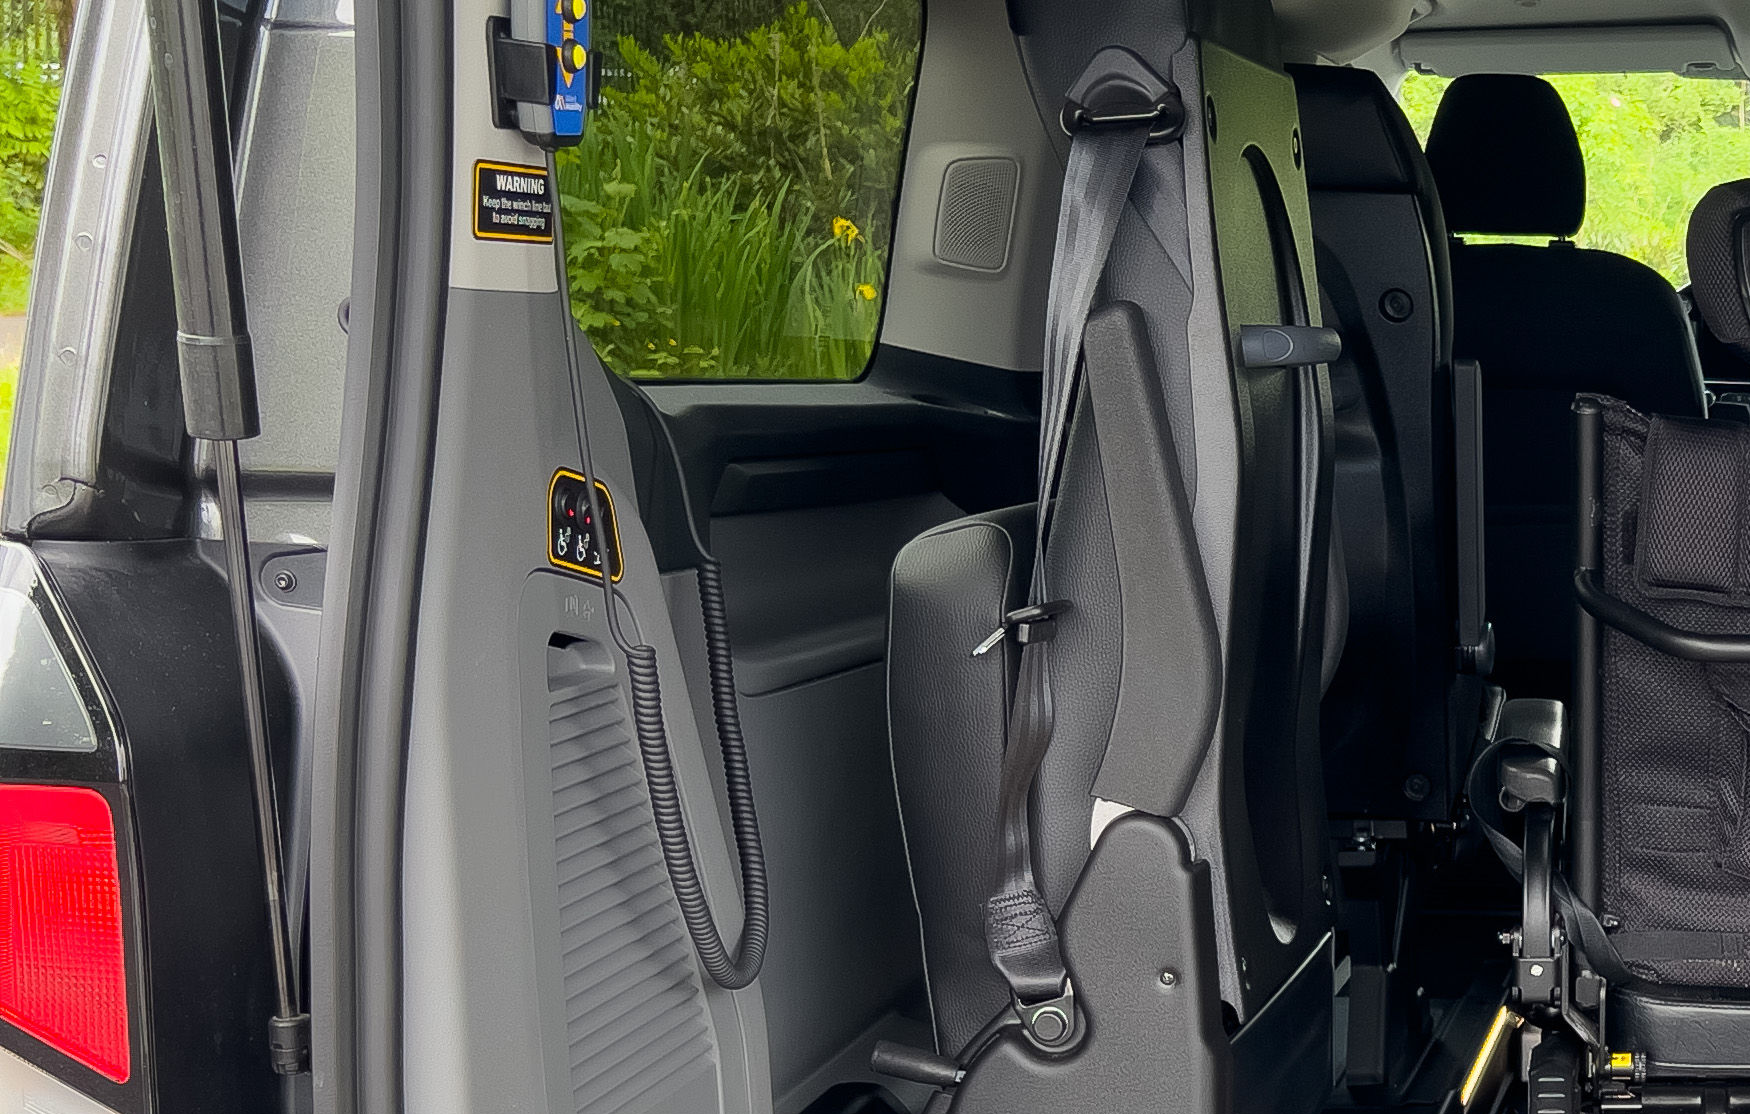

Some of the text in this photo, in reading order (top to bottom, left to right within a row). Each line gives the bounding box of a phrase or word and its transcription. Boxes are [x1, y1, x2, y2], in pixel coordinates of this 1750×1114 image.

[496, 174, 545, 195] WARNING
[483, 195, 501, 211] Keep
[501, 197, 511, 210] the
[492, 211, 546, 230] to avoid snagging
